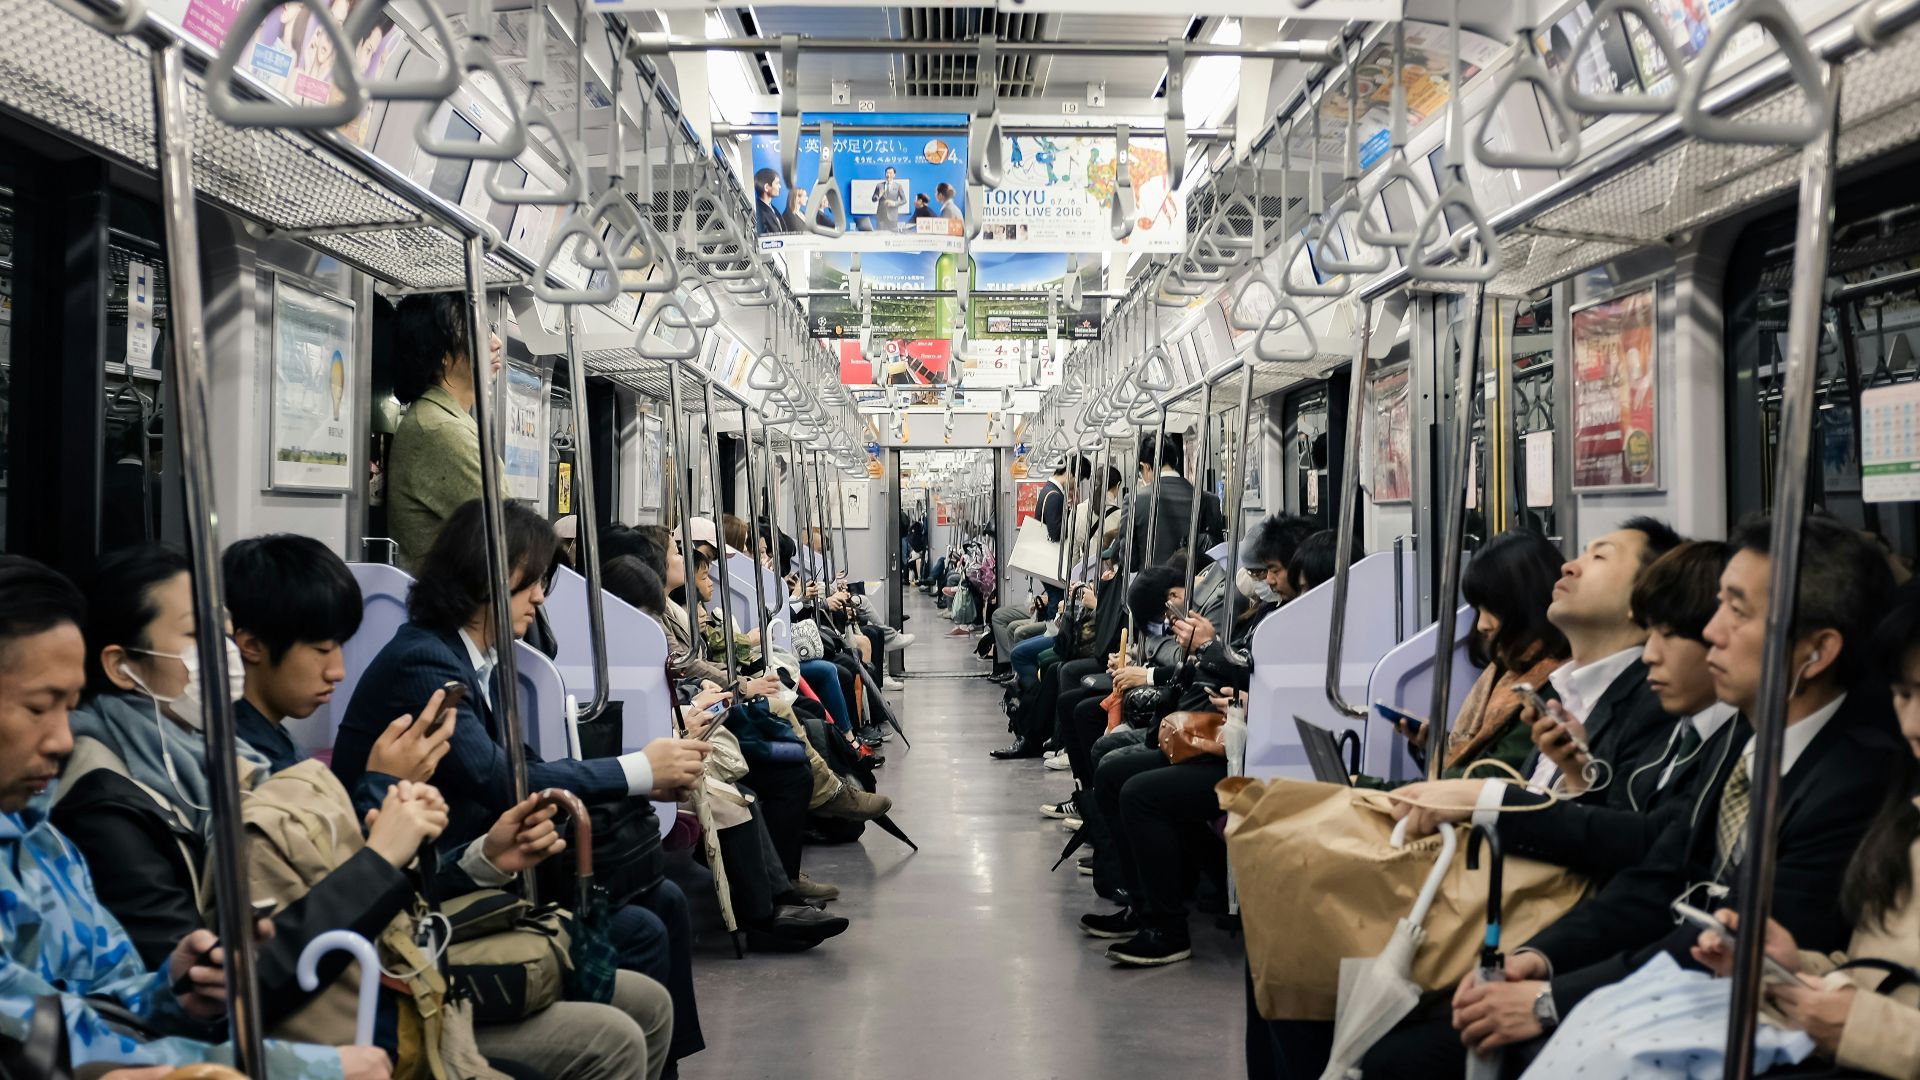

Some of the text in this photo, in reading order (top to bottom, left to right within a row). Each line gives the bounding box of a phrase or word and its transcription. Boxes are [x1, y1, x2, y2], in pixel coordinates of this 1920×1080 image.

[859, 102, 874, 111] 20
[1064, 103, 1076, 113] 19
[984, 189, 1046, 205] TOKYU
[982, 207, 1083, 217] MUSIC LIVE 2016
